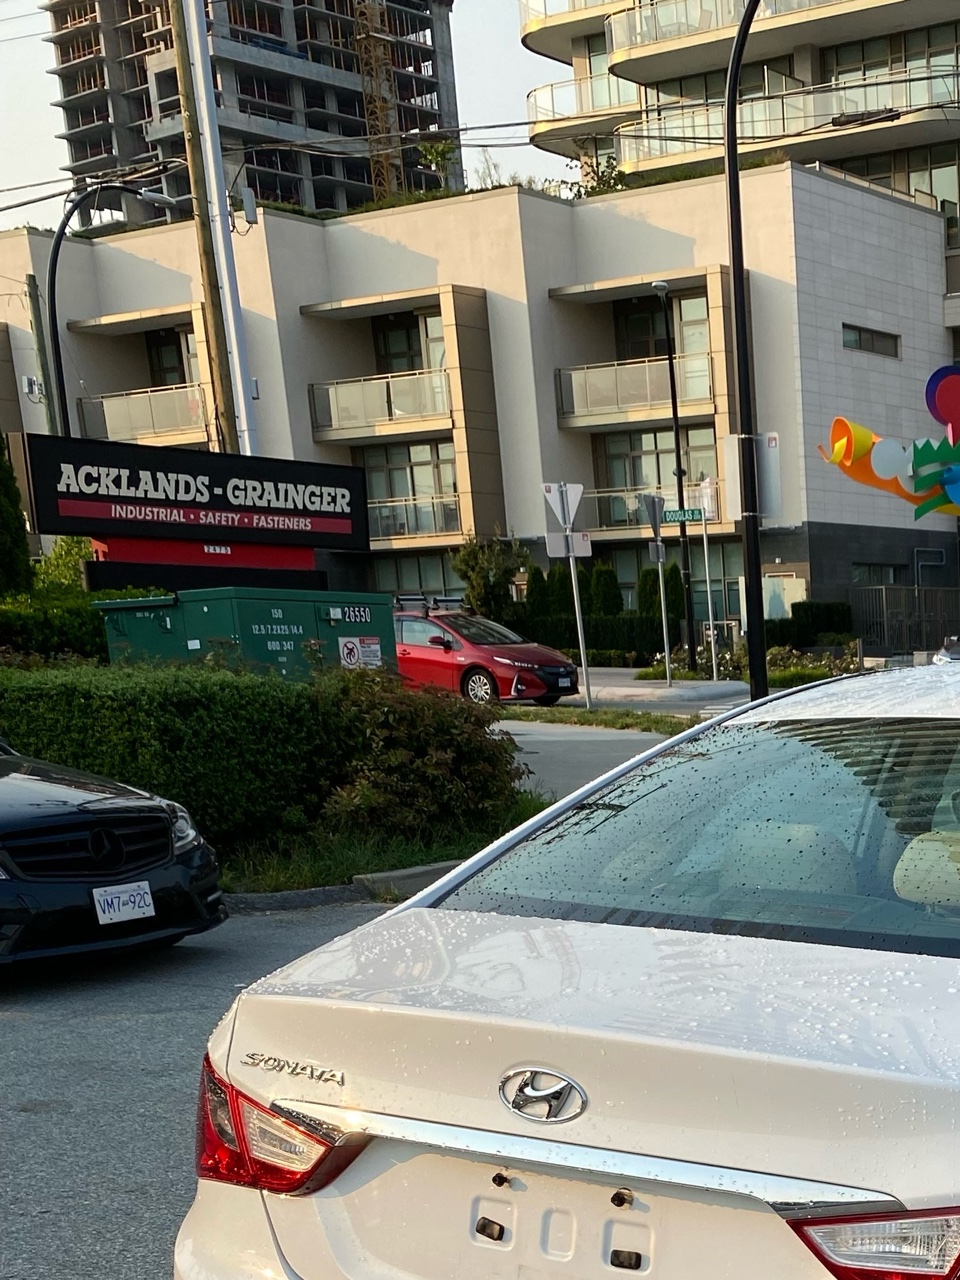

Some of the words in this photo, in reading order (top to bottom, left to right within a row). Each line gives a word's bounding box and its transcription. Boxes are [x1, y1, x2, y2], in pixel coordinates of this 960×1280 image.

[111, 504, 187, 522] INDUSTRIAL
[199, 511, 241, 526] SAFETY
[253, 515, 312, 531] FASTENERS
[666, 510, 692, 521] DOUGLAS
[344, 606, 371, 622] 26550
[240, 1053, 345, 1086] SONATA
